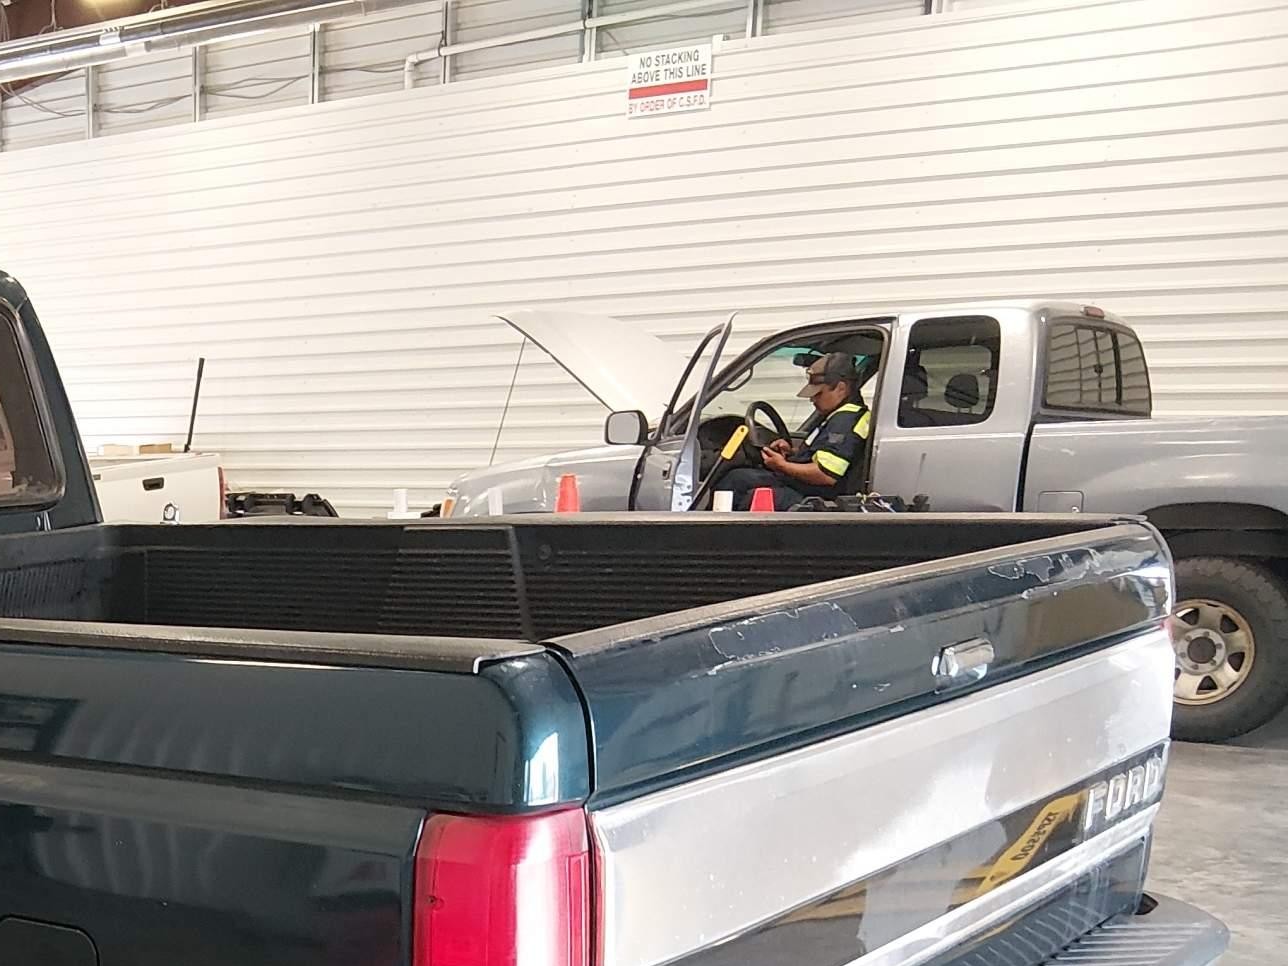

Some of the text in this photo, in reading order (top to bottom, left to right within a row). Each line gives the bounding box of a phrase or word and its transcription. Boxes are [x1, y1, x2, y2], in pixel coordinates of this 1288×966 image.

[639, 49, 700, 70] NO STACKING
[631, 63, 707, 84] ABOVE THIS LINE
[628, 103, 638, 114] BY
[640, 99, 665, 112] ORDER
[666, 97, 677, 109] OF
[1083, 756, 1163, 831] FORD
